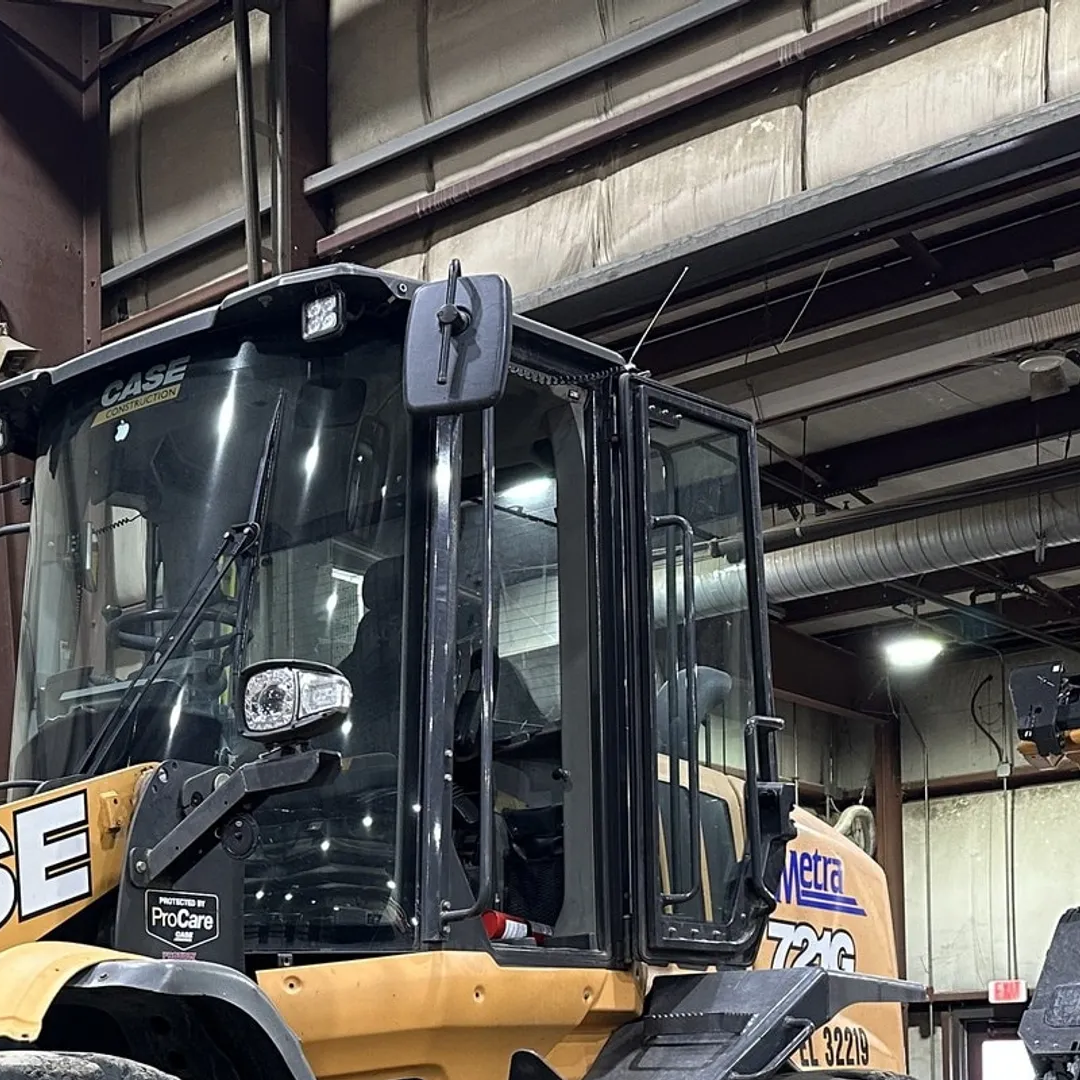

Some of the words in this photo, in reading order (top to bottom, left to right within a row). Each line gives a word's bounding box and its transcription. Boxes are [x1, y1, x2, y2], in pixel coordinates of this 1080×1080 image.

[102, 355, 191, 407] CASE
[105, 388, 177, 418] CONSTRUCTION
[776, 848, 843, 906] Metra
[151, 906, 214, 930] ProCare
[159, 897, 196, 907] PROTECTED
[197, 900, 206, 908] BY
[767, 918, 856, 972] 721G
[994, 981, 1021, 1001] EXIT
[823, 1026, 869, 1067] 32219
